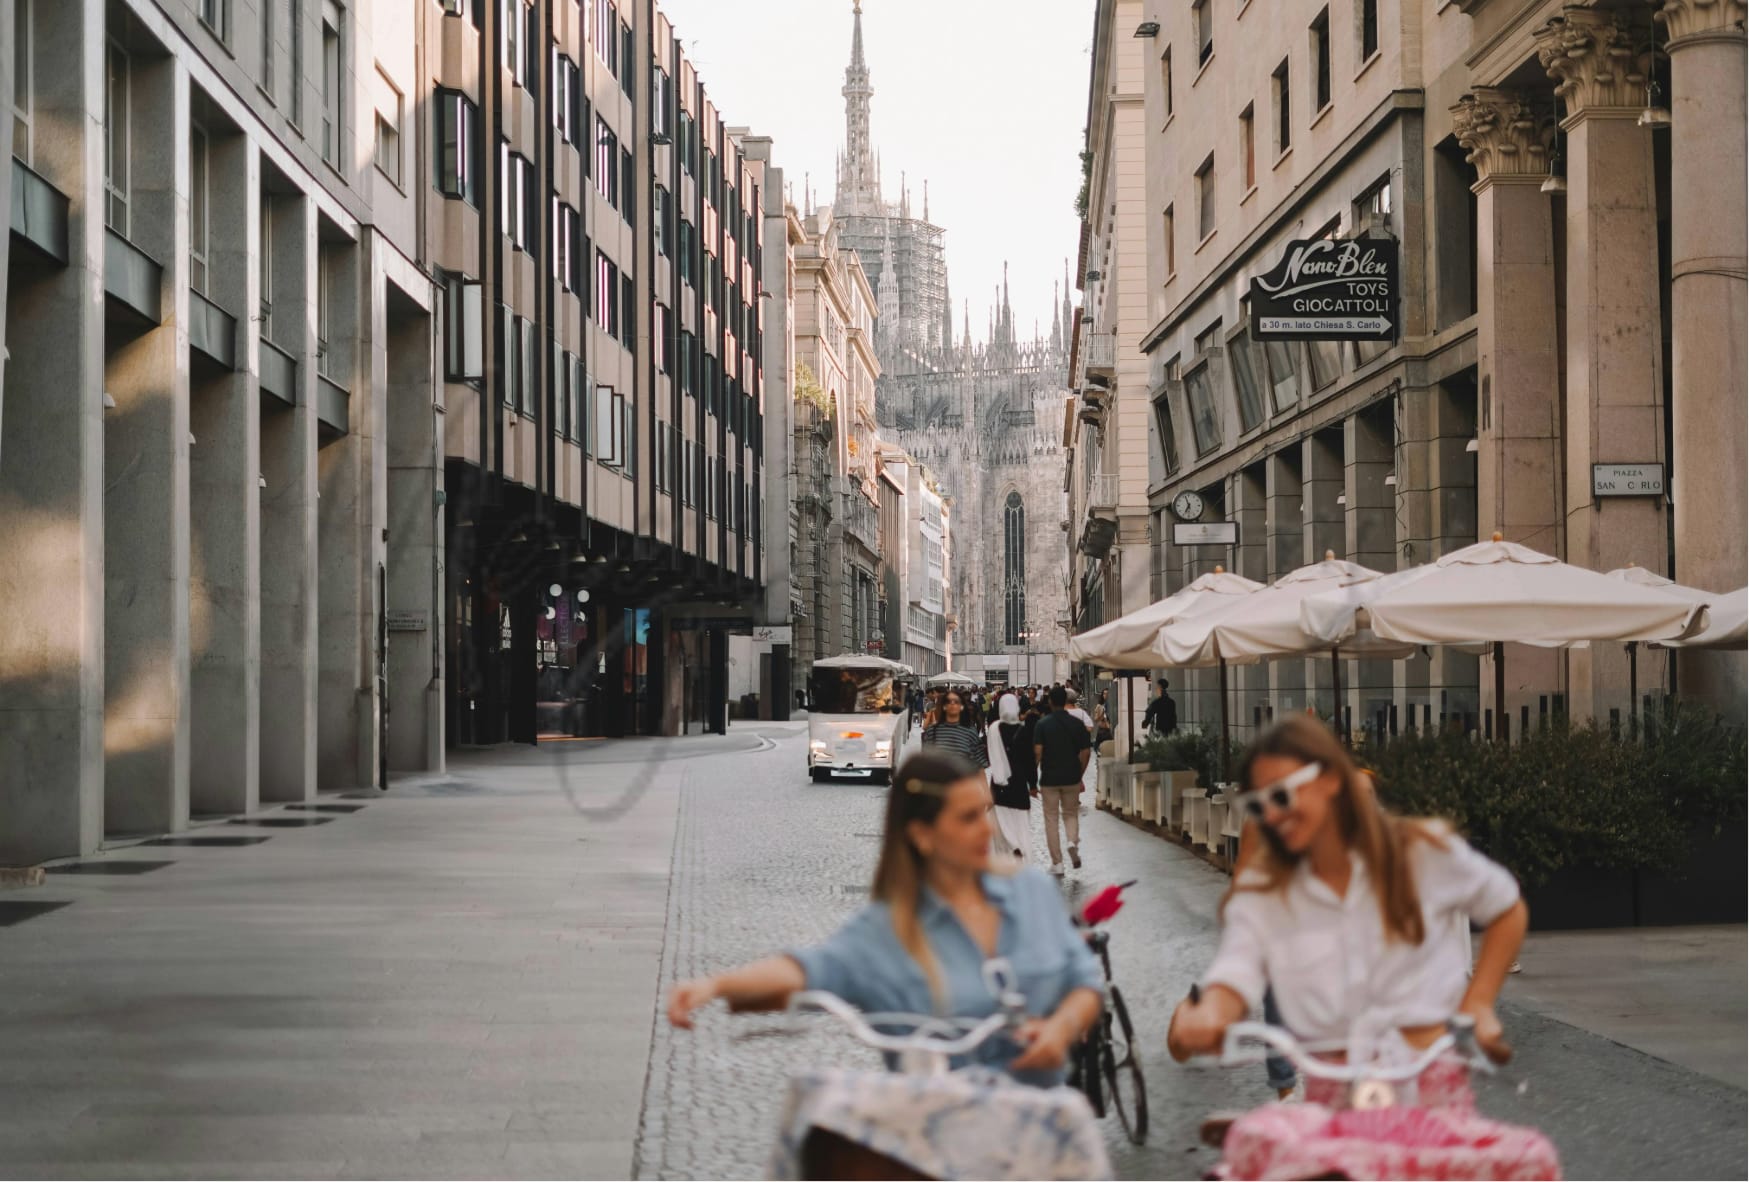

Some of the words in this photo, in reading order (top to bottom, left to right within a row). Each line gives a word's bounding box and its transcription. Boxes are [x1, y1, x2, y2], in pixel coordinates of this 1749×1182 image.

[1257, 240, 1337, 291] Nano
[1347, 282, 1389, 295] TOYS
[1293, 298, 1389, 312] GIOCATTOLI
[1269, 321, 1280, 329] 30
[1295, 321, 1312, 329] lato
[1314, 321, 1344, 329] Chiesa
[1346, 321, 1355, 329] S.
[1357, 321, 1381, 329] Carlo
[1597, 481, 1616, 490] SAN
